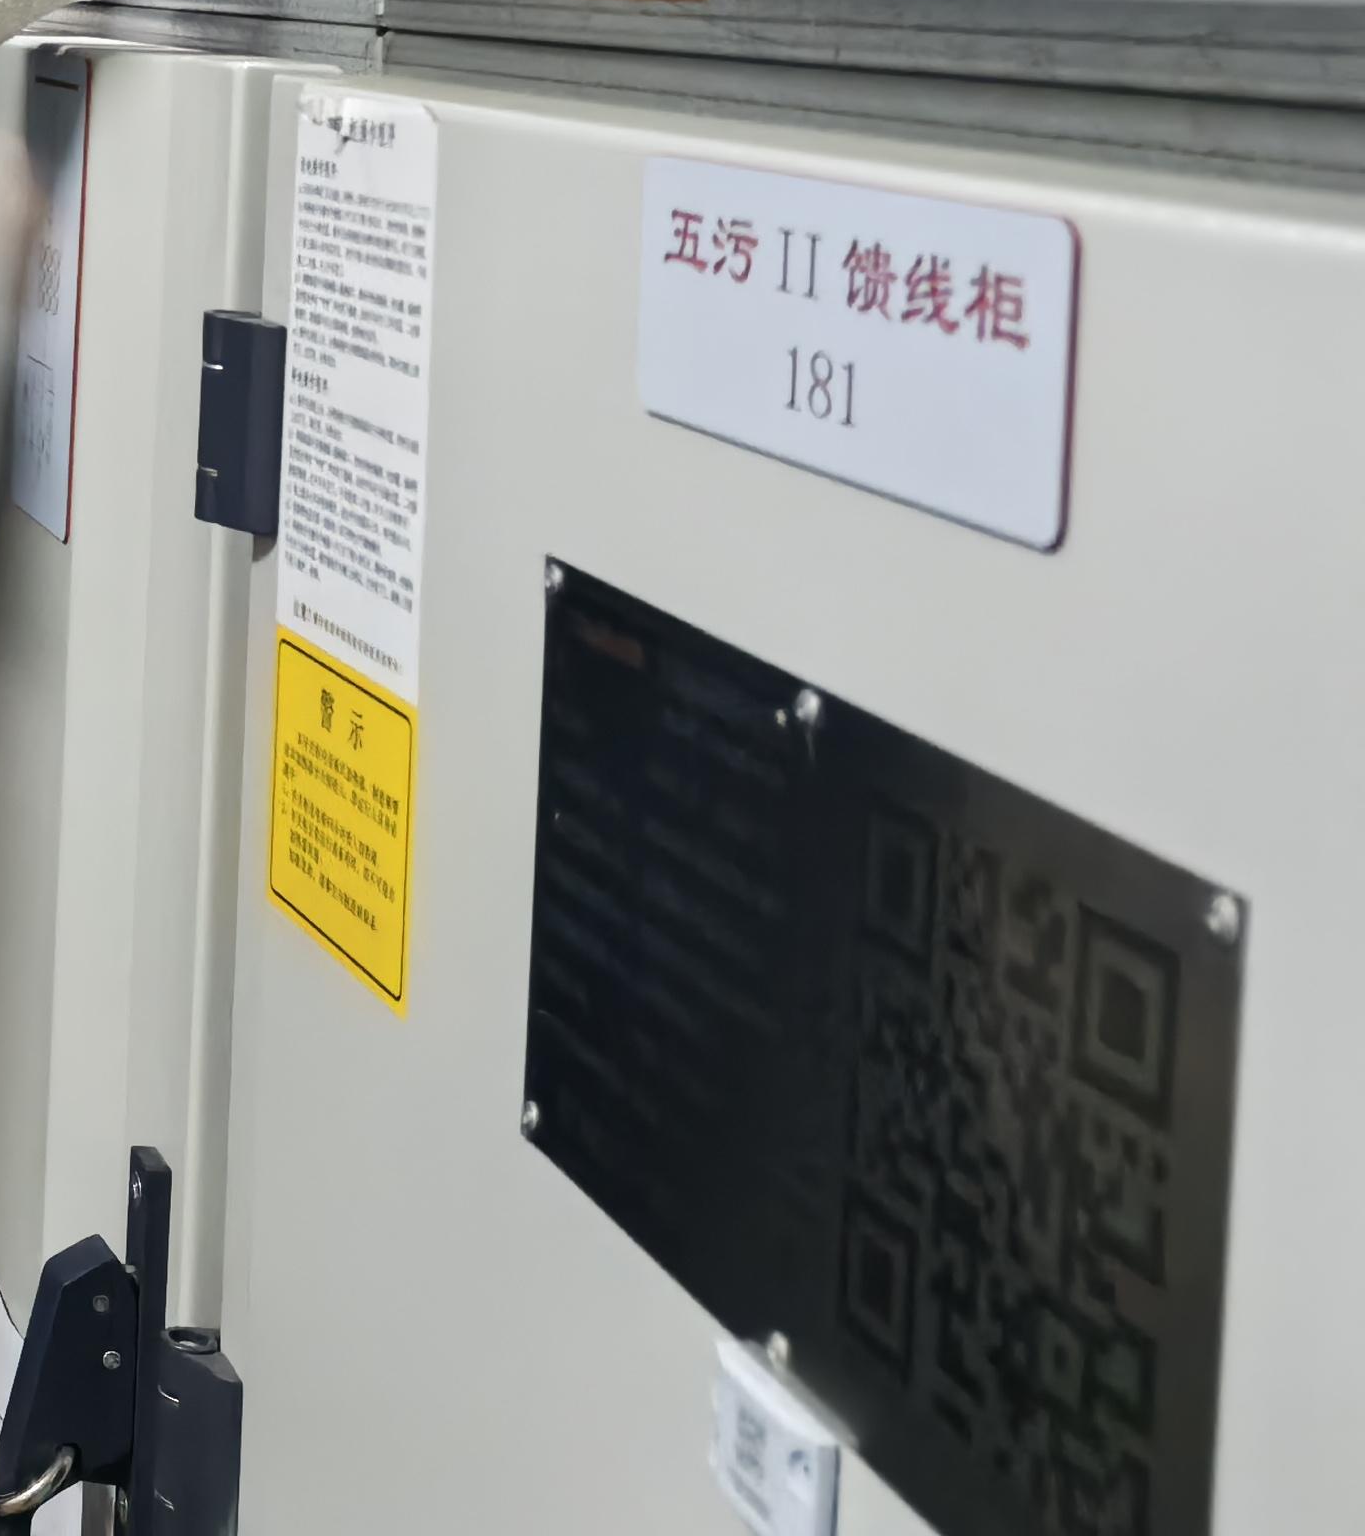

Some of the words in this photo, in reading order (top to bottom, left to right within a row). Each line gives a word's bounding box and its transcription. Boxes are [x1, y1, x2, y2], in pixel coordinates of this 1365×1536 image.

[664, 208, 760, 284] 五污
[776, 227, 823, 301] II
[841, 237, 1032, 351] 馈线柜
[784, 346, 859, 428] 181
